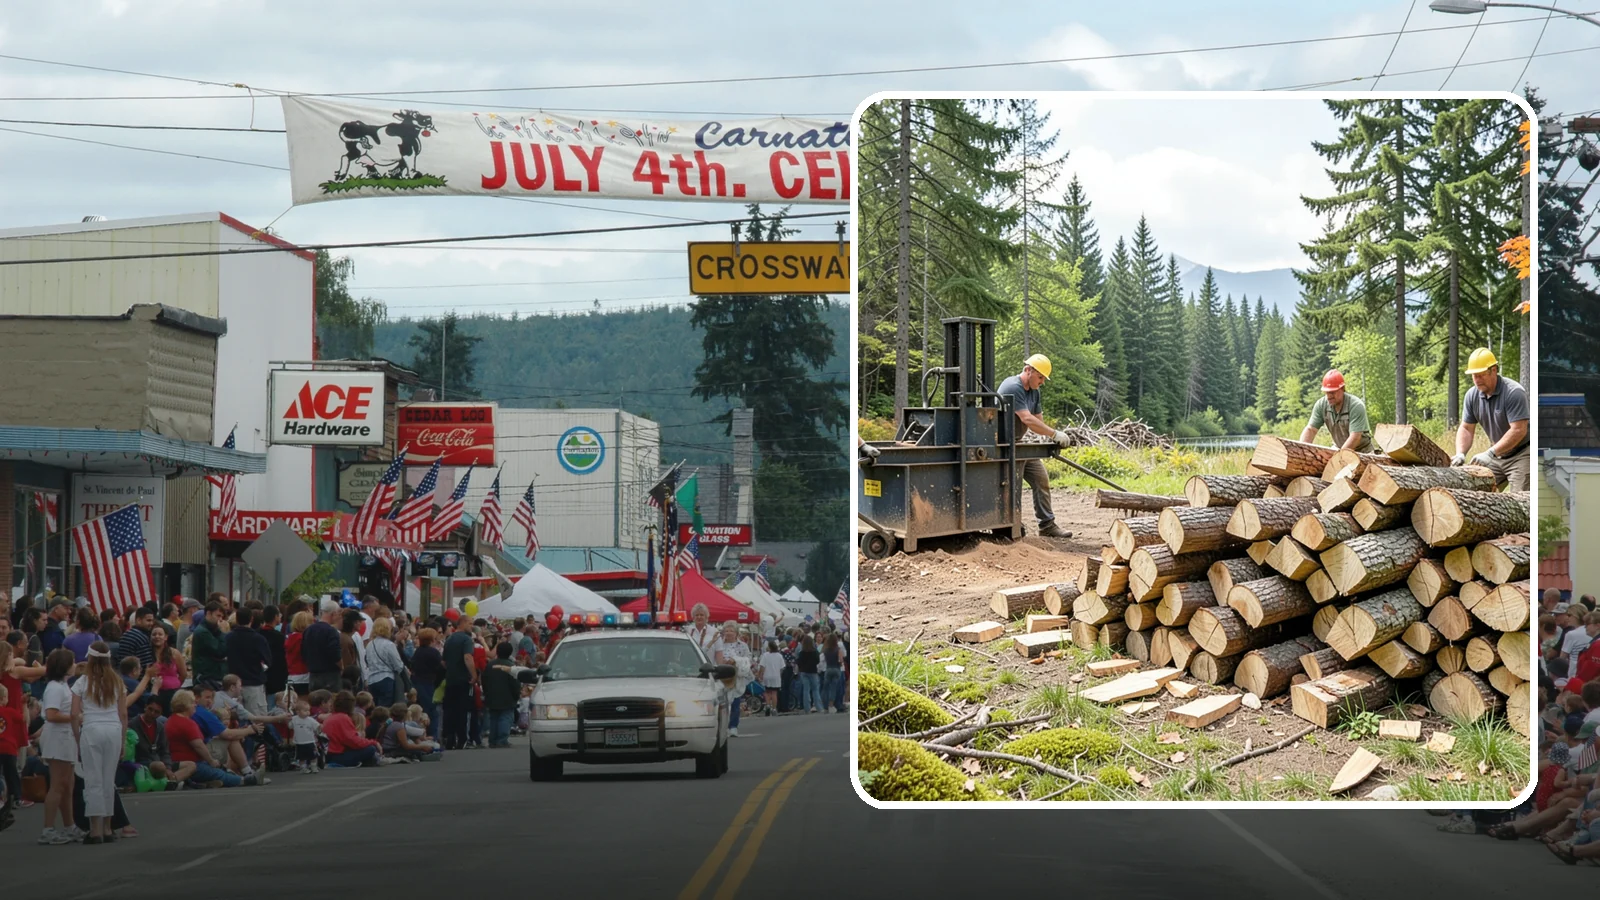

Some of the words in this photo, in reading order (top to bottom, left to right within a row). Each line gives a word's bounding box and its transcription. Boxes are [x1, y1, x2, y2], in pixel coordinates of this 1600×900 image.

[481, 141, 605, 192] JULY
[632, 150, 746, 197] 4th.
[697, 254, 850, 280] CROSSWA
[282, 380, 373, 420] ACE
[406, 409, 452, 422] CEDAR
[283, 421, 371, 436] Hardware
[416, 428, 477, 447] Coca-Cola
[353, 467, 386, 480] Simpl
[83, 485, 93, 494] St.
[96, 485, 123, 495] Vincent
[126, 486, 136, 494] de
[138, 486, 155, 495] Paul
[81, 503, 154, 522] THT
[688, 527, 741, 535] CRNATION
[699, 535, 730, 543] GLASS
